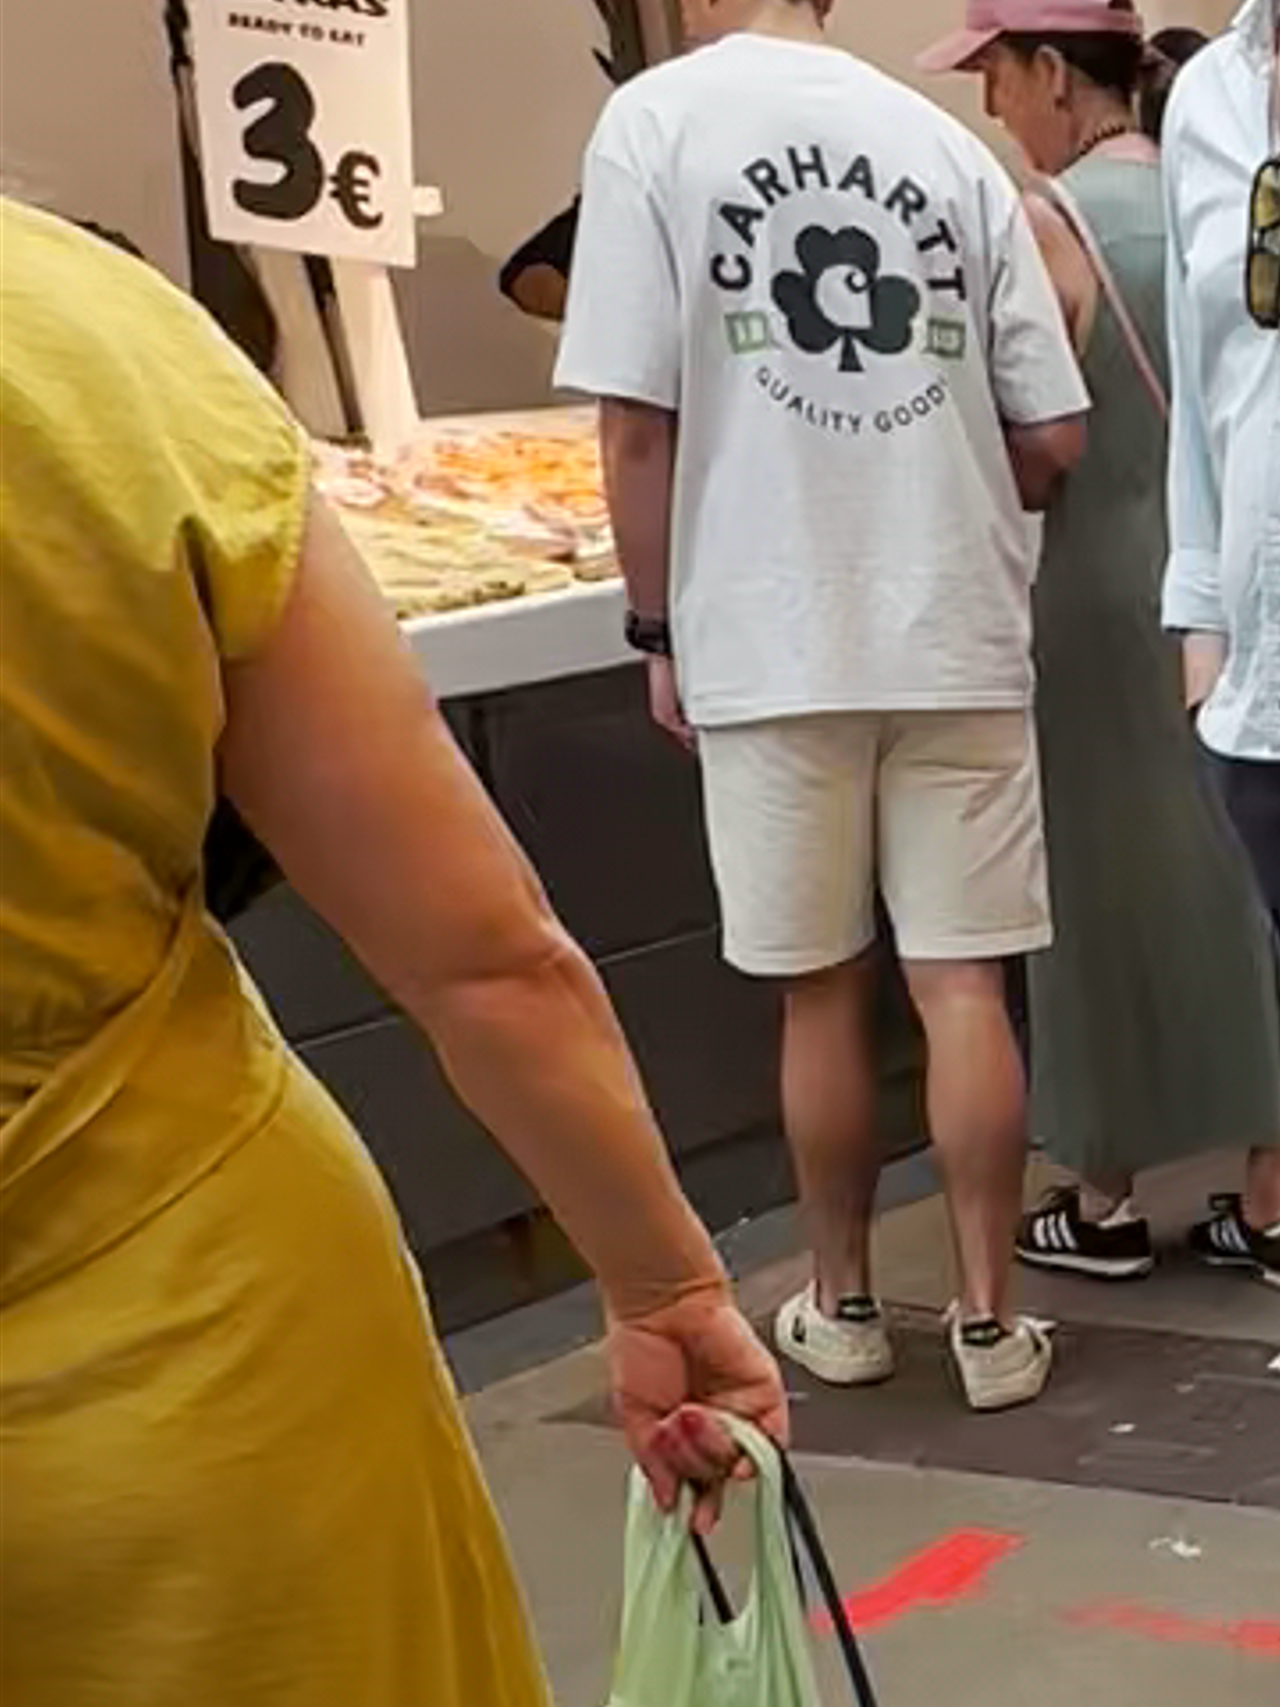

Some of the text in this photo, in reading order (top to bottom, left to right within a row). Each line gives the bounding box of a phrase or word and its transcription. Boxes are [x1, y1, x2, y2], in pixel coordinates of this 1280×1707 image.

[228, 12, 366, 47] READY TO EAT
[231, 61, 385, 230] 3€
[709, 144, 968, 302] CARHARTT
[754, 365, 864, 435] QUALITY
